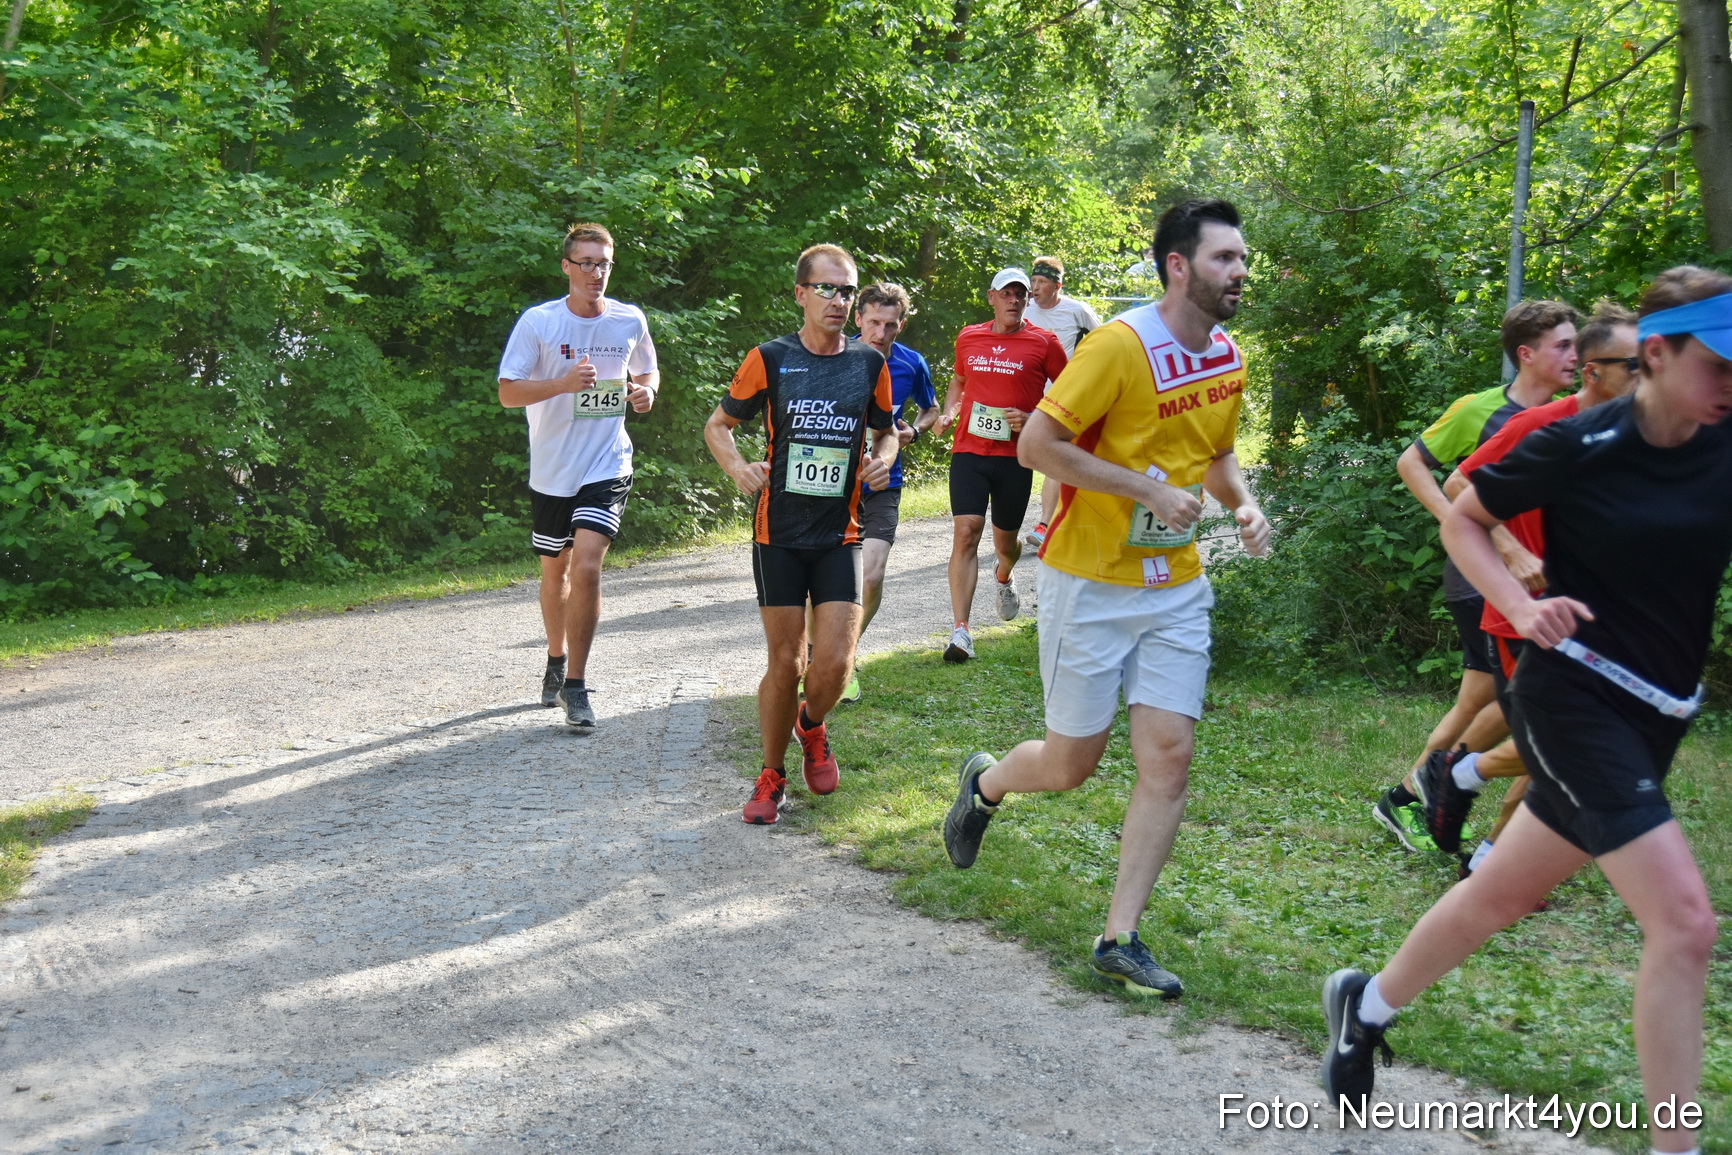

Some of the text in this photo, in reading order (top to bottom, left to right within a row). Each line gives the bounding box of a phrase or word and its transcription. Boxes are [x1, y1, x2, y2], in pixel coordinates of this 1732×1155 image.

[993, 367, 1015, 375] FRISCH
[580, 393, 619, 407] 2145
[1158, 379, 1243, 419] MAX BÖGL
[786, 400, 837, 414] HECK
[791, 415, 857, 432] DESIGN
[977, 417, 1002, 431] 583
[795, 462, 841, 483] 1018
